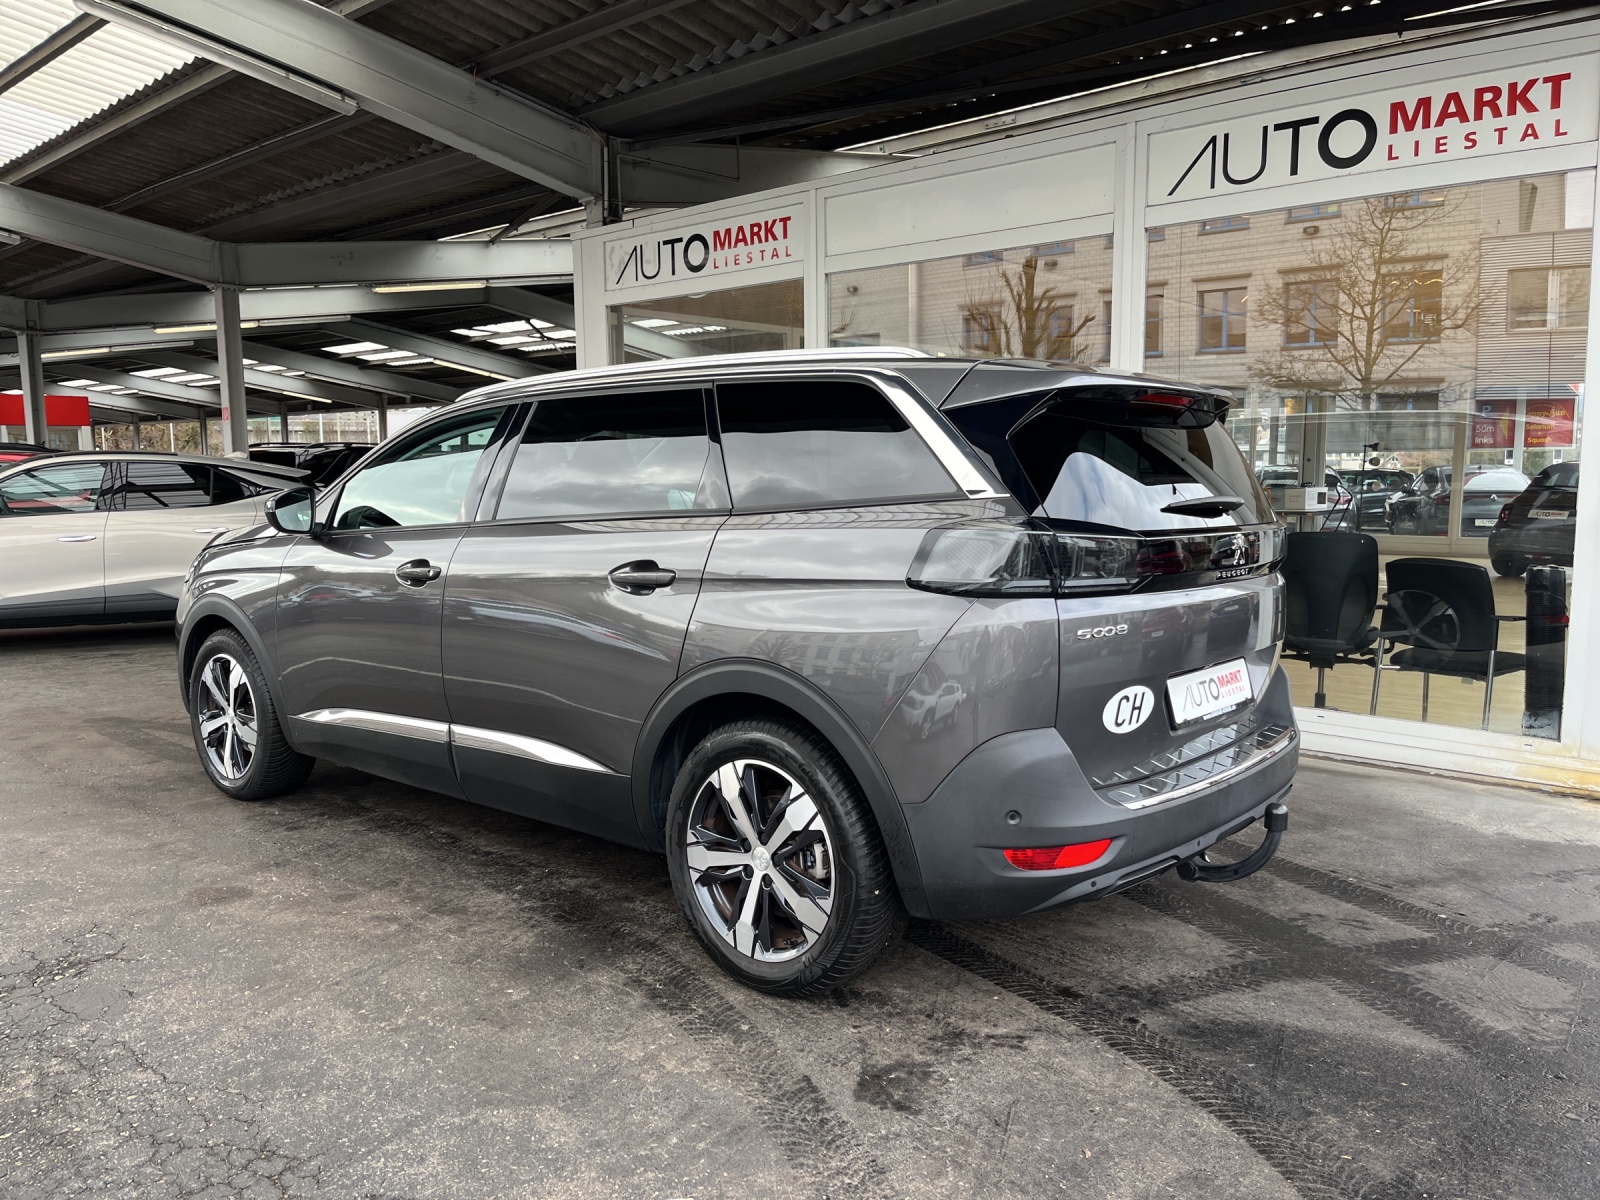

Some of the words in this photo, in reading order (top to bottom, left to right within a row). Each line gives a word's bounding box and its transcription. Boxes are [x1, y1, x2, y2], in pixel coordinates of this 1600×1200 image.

[1167, 108, 1378, 197] AUTO
[1388, 72, 1572, 135] MARKT
[1387, 118, 1568, 161] LIESTAL
[616, 233, 710, 285] AUTO
[712, 216, 792, 252] MARKT
[713, 245, 792, 269] LIESTAL
[1475, 424, 1495, 433] 50m
[1474, 436, 1494, 444] links
[1527, 436, 1552, 444] Squash
[1216, 568, 1249, 579] PEUGEOT
[1076, 624, 1129, 640] 5008
[1183, 677, 1220, 712] AUTO
[1216, 669, 1243, 689] MARKT
[1221, 684, 1245, 699] LIESTAL
[1114, 691, 1145, 728] CH
